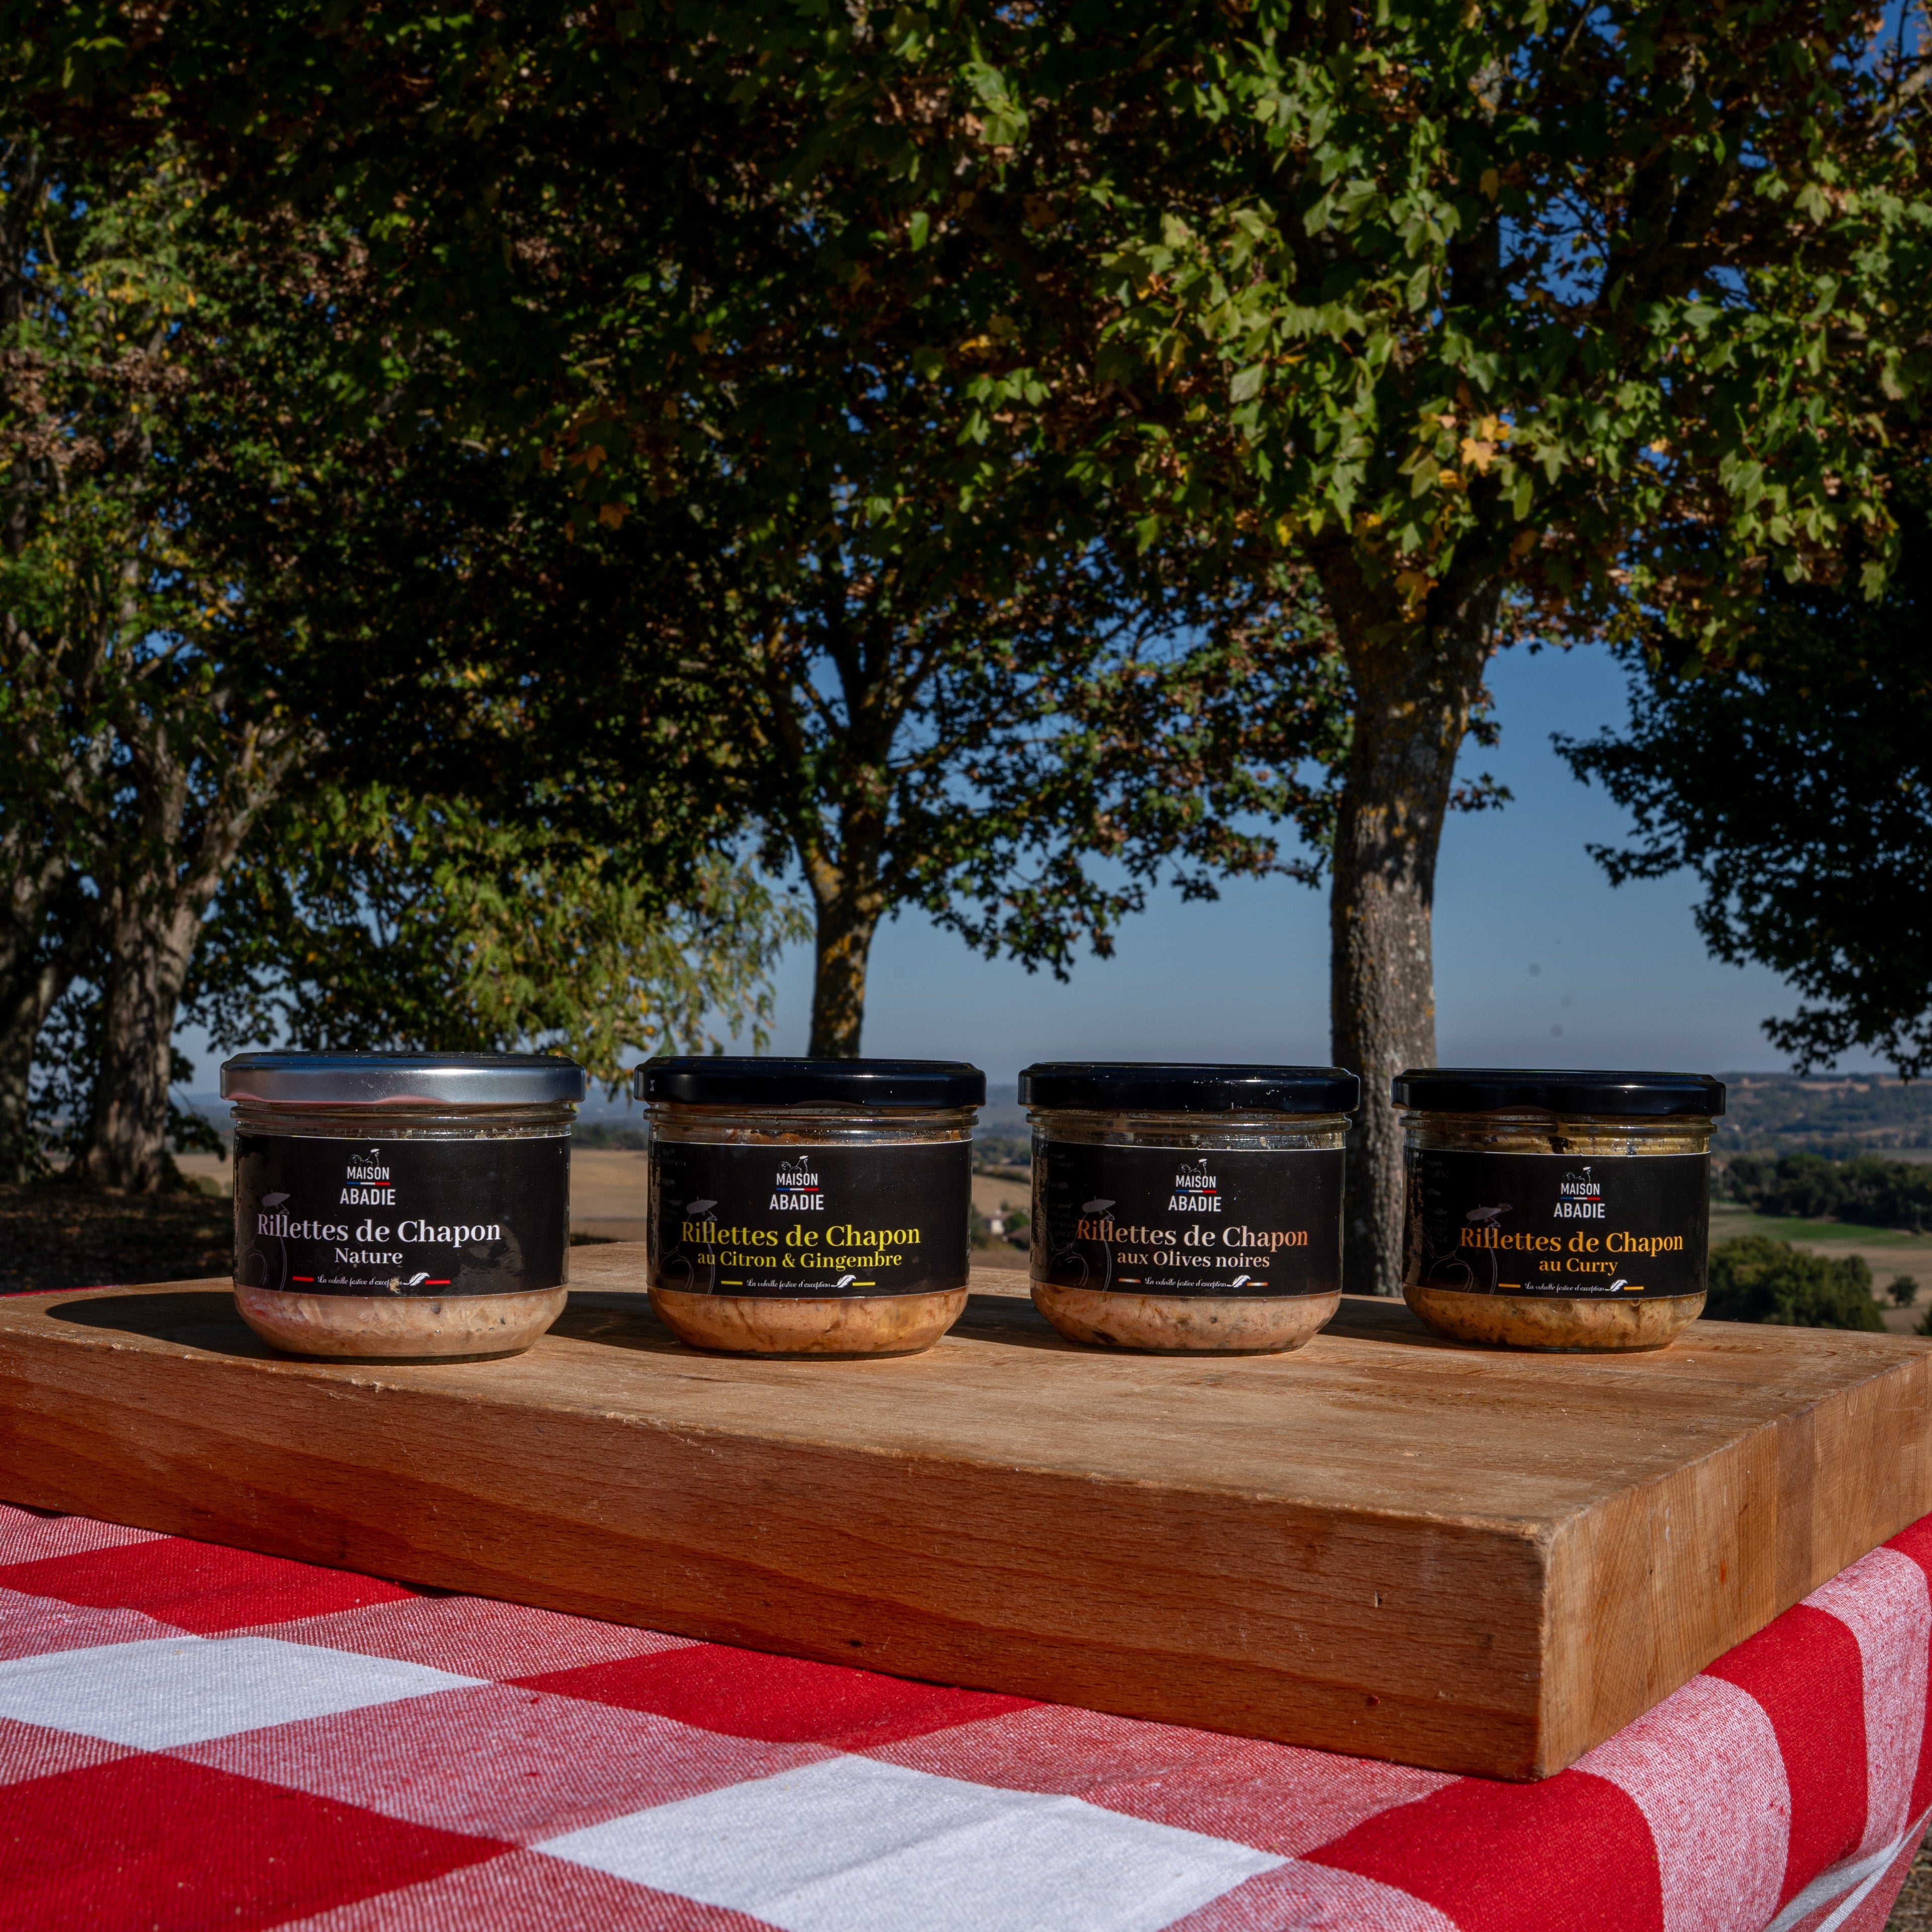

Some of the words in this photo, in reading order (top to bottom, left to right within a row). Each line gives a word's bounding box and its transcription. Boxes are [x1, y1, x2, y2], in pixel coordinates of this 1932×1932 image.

[347, 1166, 389, 1181] MAISON
[776, 1173, 818, 1186] MAISON
[1175, 1175, 1216, 1188] MAISON
[340, 1188, 396, 1205] ABADIE
[1561, 1183, 1600, 1195] MAISON
[769, 1194, 824, 1211] ABADIE
[1168, 1196, 1222, 1212] ABADIE
[1554, 1203, 1605, 1219] ABADIE
[257, 1213, 348, 1242] Rillettes
[356, 1220, 390, 1242] de
[397, 1220, 502, 1248] Chapon
[682, 1222, 778, 1247] Rillettes
[785, 1225, 819, 1247] de
[826, 1225, 921, 1251] Chapon
[1077, 1220, 1176, 1247] Rillettes
[1183, 1225, 1216, 1247] de
[1222, 1225, 1309, 1253] Chapon
[1460, 1227, 1561, 1252] Rillettes
[1568, 1231, 1599, 1252] de
[1606, 1232, 1683, 1257] Chapon
[335, 1247, 403, 1264] Nature
[697, 1254, 715, 1266] au
[720, 1251, 777, 1267] Citron
[782, 1254, 795, 1267] &
[800, 1252, 902, 1271] Gingembre
[1116, 1252, 1148, 1265] aux
[1153, 1249, 1211, 1267] Olives
[1216, 1251, 1270, 1268] noires
[1539, 1260, 1561, 1272] au
[1566, 1259, 1618, 1276] Curry
